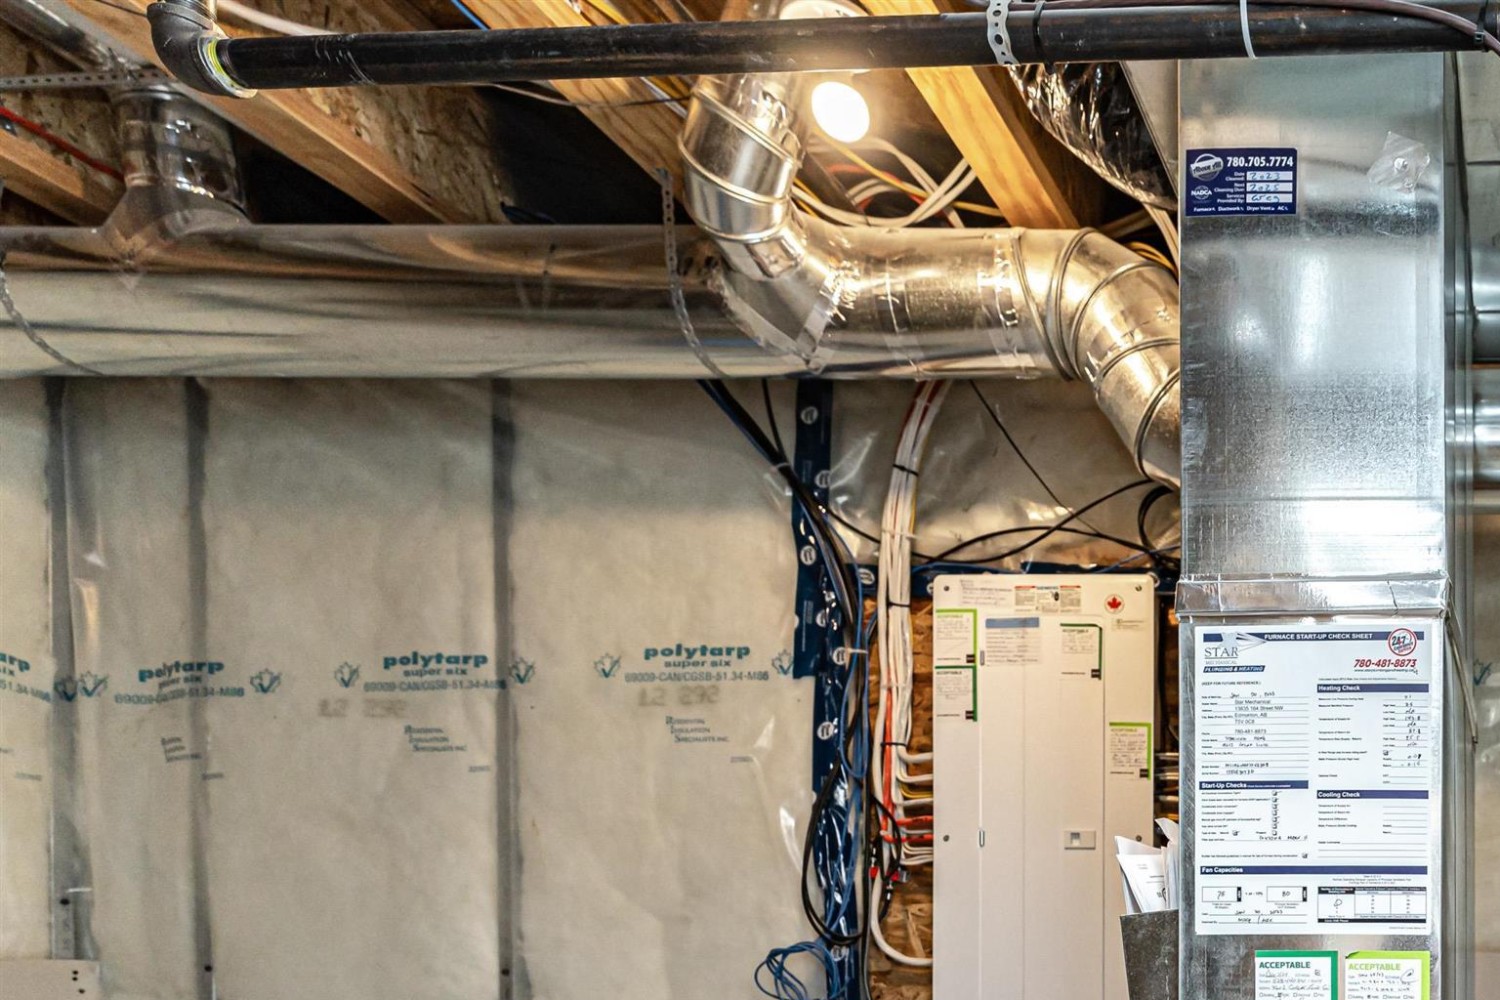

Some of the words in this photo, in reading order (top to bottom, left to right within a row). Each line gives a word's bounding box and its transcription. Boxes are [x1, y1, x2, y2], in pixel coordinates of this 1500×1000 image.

[1227, 156, 1293, 167] 780.705.7774
[643, 643, 751, 660] polytarp
[1204, 647, 1239, 657] STAR
[383, 651, 488, 669] polytarp
[664, 660, 706, 668] super
[710, 659, 731, 667] six
[1354, 659, 1418, 668] 780-481-8873
[138, 661, 224, 682] polytarp
[403, 668, 442, 678] super
[446, 667, 468, 675] six
[1259, 961, 1311, 969] ACCEPTABLE
[1348, 963, 1401, 971] ACCEPTABLE
